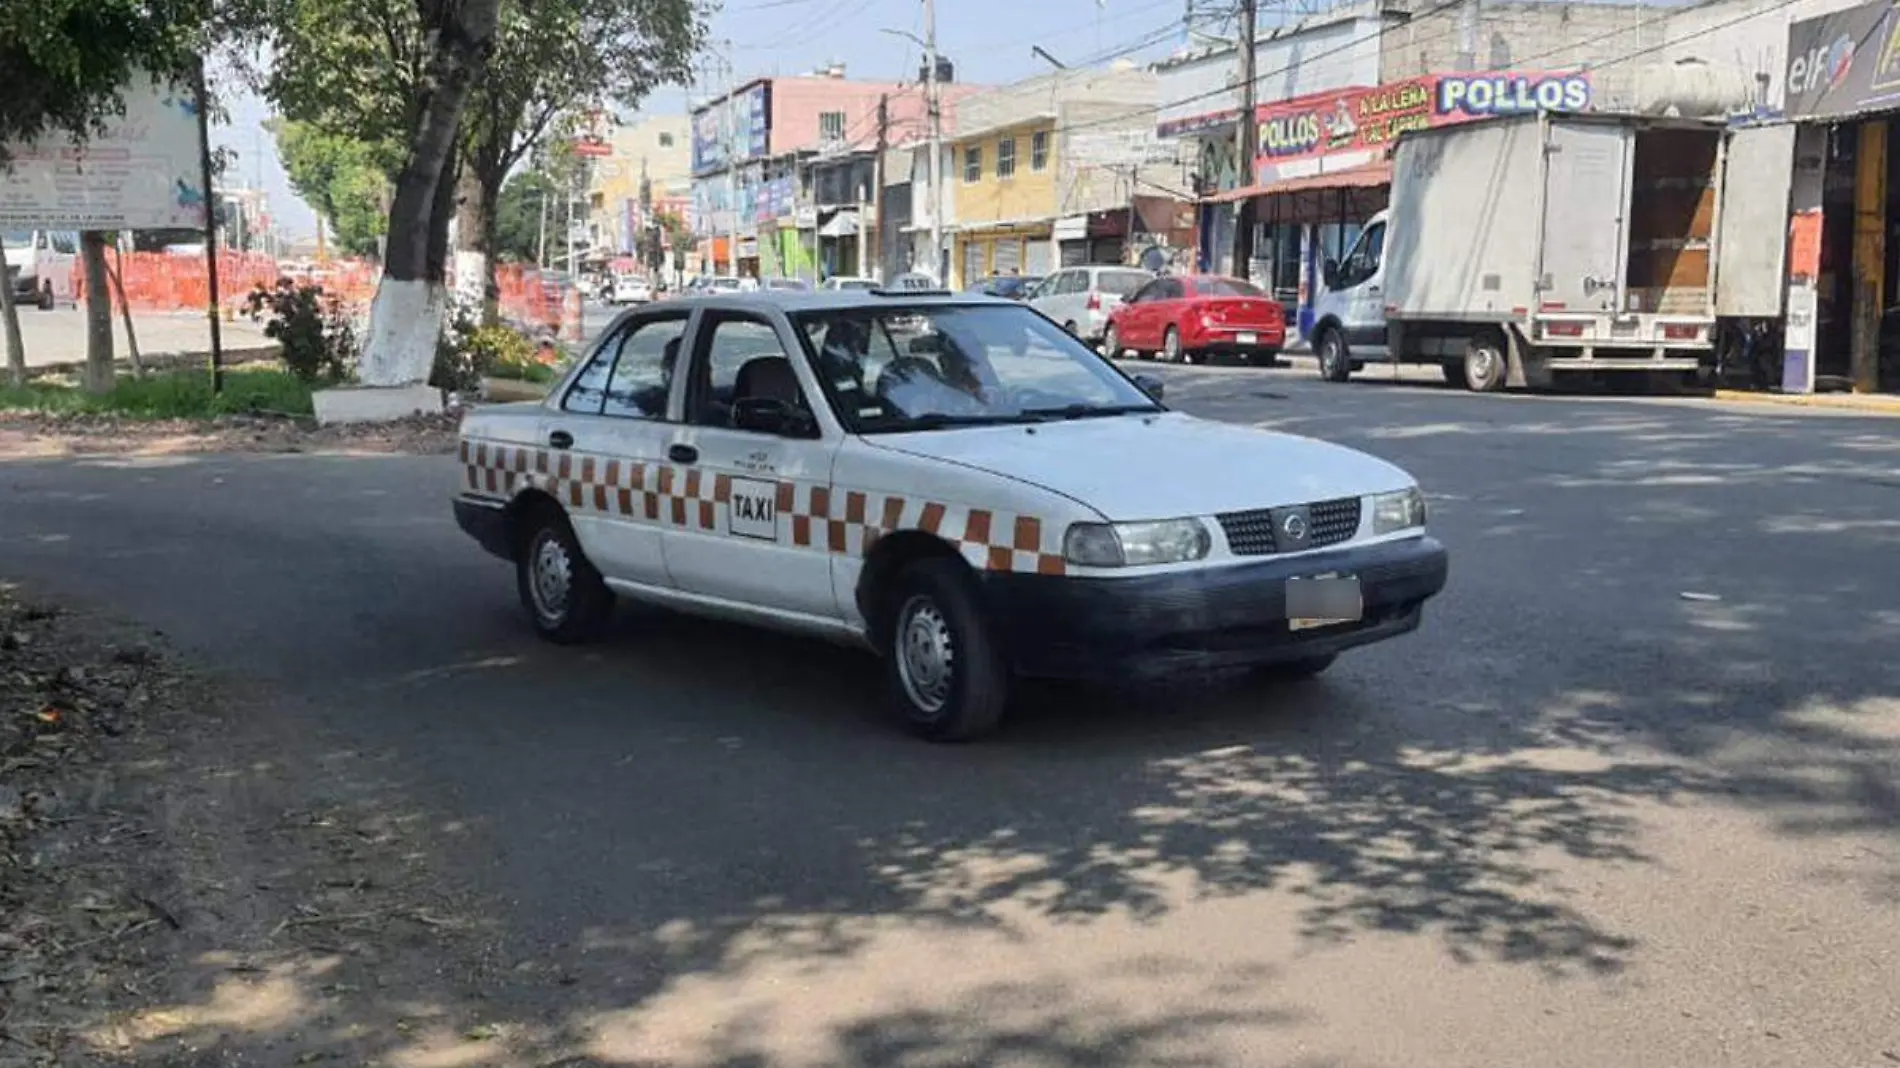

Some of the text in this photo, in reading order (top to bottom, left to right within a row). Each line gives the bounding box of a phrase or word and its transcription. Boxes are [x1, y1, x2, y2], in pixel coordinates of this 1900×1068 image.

[1443, 79, 1587, 111] POLLOS
[1259, 113, 1318, 150] POLLOS
[734, 494, 773, 522] TAXI
